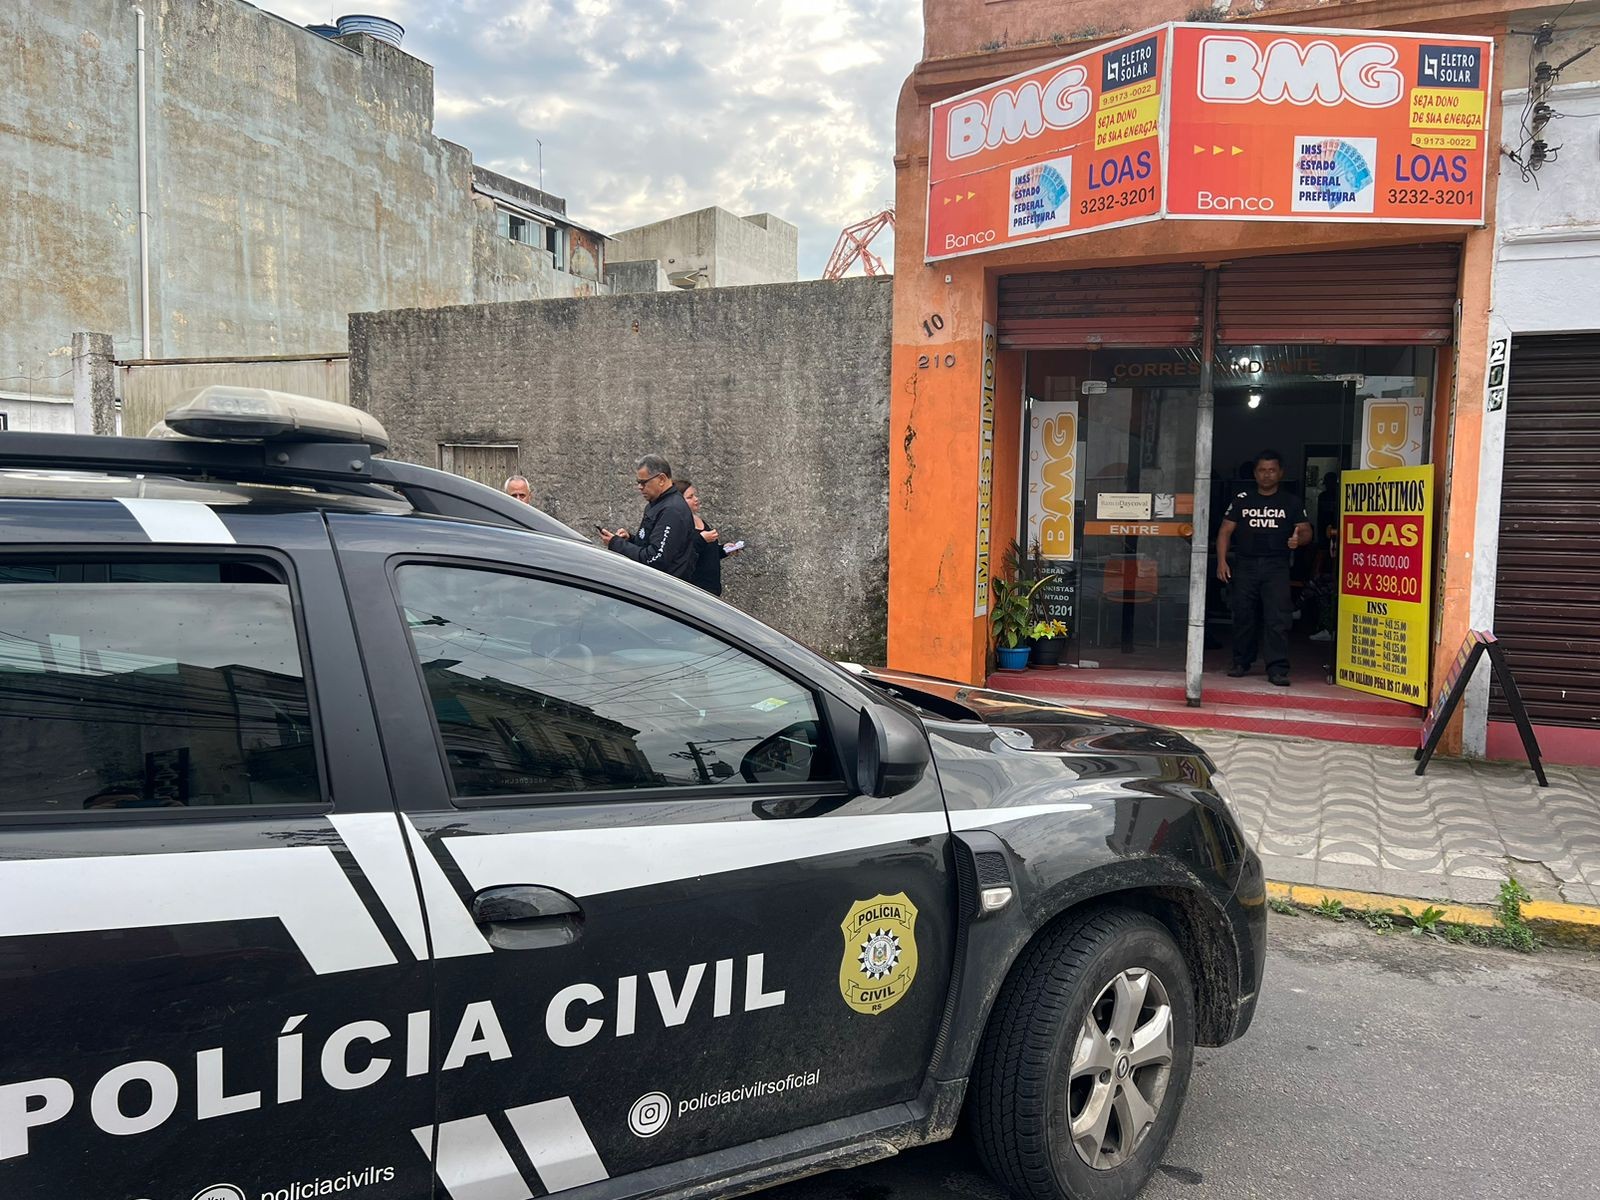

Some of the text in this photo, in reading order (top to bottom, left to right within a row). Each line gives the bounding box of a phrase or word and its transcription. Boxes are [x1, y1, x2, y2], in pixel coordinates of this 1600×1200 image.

[1121, 45, 1152, 67] ELETRO
[1441, 53, 1475, 68] ELETRO
[1121, 62, 1148, 82] SOLAR
[1197, 35, 1404, 108] BMG
[1440, 69, 1471, 83] SOLAR
[1413, 95, 1459, 110] SEJA DONO
[946, 65, 1092, 161] BMG
[1097, 108, 1137, 129] SEJA DONO
[1412, 112, 1424, 124] DE
[1426, 112, 1443, 125] SUA
[1097, 133, 1108, 146] DE
[1108, 128, 1123, 142] SUA
[1301, 144, 1322, 155] INSS
[1088, 150, 1151, 190] LOAS
[1300, 160, 1336, 171] ESTADO
[1396, 153, 1468, 183] LOAS
[1015, 173, 1031, 186] INSS
[1299, 175, 1341, 186] FEDERAL
[1014, 185, 1041, 200] ESTADO
[1080, 186, 1156, 215] 3232-3201
[1197, 190, 1274, 211] Banco
[1299, 190, 1356, 202] PREFEITURA
[1388, 188, 1474, 205] 3232-3201
[1013, 199, 1045, 214] FEDERAL
[1013, 210, 1056, 228] PREFEITURA
[945, 229, 996, 250] Banco
[922, 313, 944, 338] 10
[918, 354, 956, 369] 210
[1040, 411, 1076, 559] BMG
[1344, 475, 1425, 513] EMPRÉSTIMOS
[1241, 506, 1286, 519] POLÍCIA
[1109, 525, 1160, 535] ENTRE
[1249, 519, 1279, 528] CIVIL
[1346, 522, 1419, 547] LOAS
[1352, 552, 1410, 571] R$ 15.000,00
[1346, 571, 1417, 597] 84 X 398,00
[1366, 601, 1388, 616] INSS
[1340, 668, 1348, 682] COM
[1348, 670, 1355, 683] UM
[1374, 675, 1386, 691] PEGA
[1387, 679, 1394, 692] R$
[1394, 681, 1419, 698] 17.000,00
[858, 905, 901, 926] POLÍCIA
[860, 986, 896, 1002] CIVIL
[871, 1003, 882, 1012] RS
[0, 952, 786, 1161] POLÍCIA CIVIL
[678, 1068, 821, 1117] policiacivilrsoficial
[261, 1164, 395, 1200] policiacivilrs
